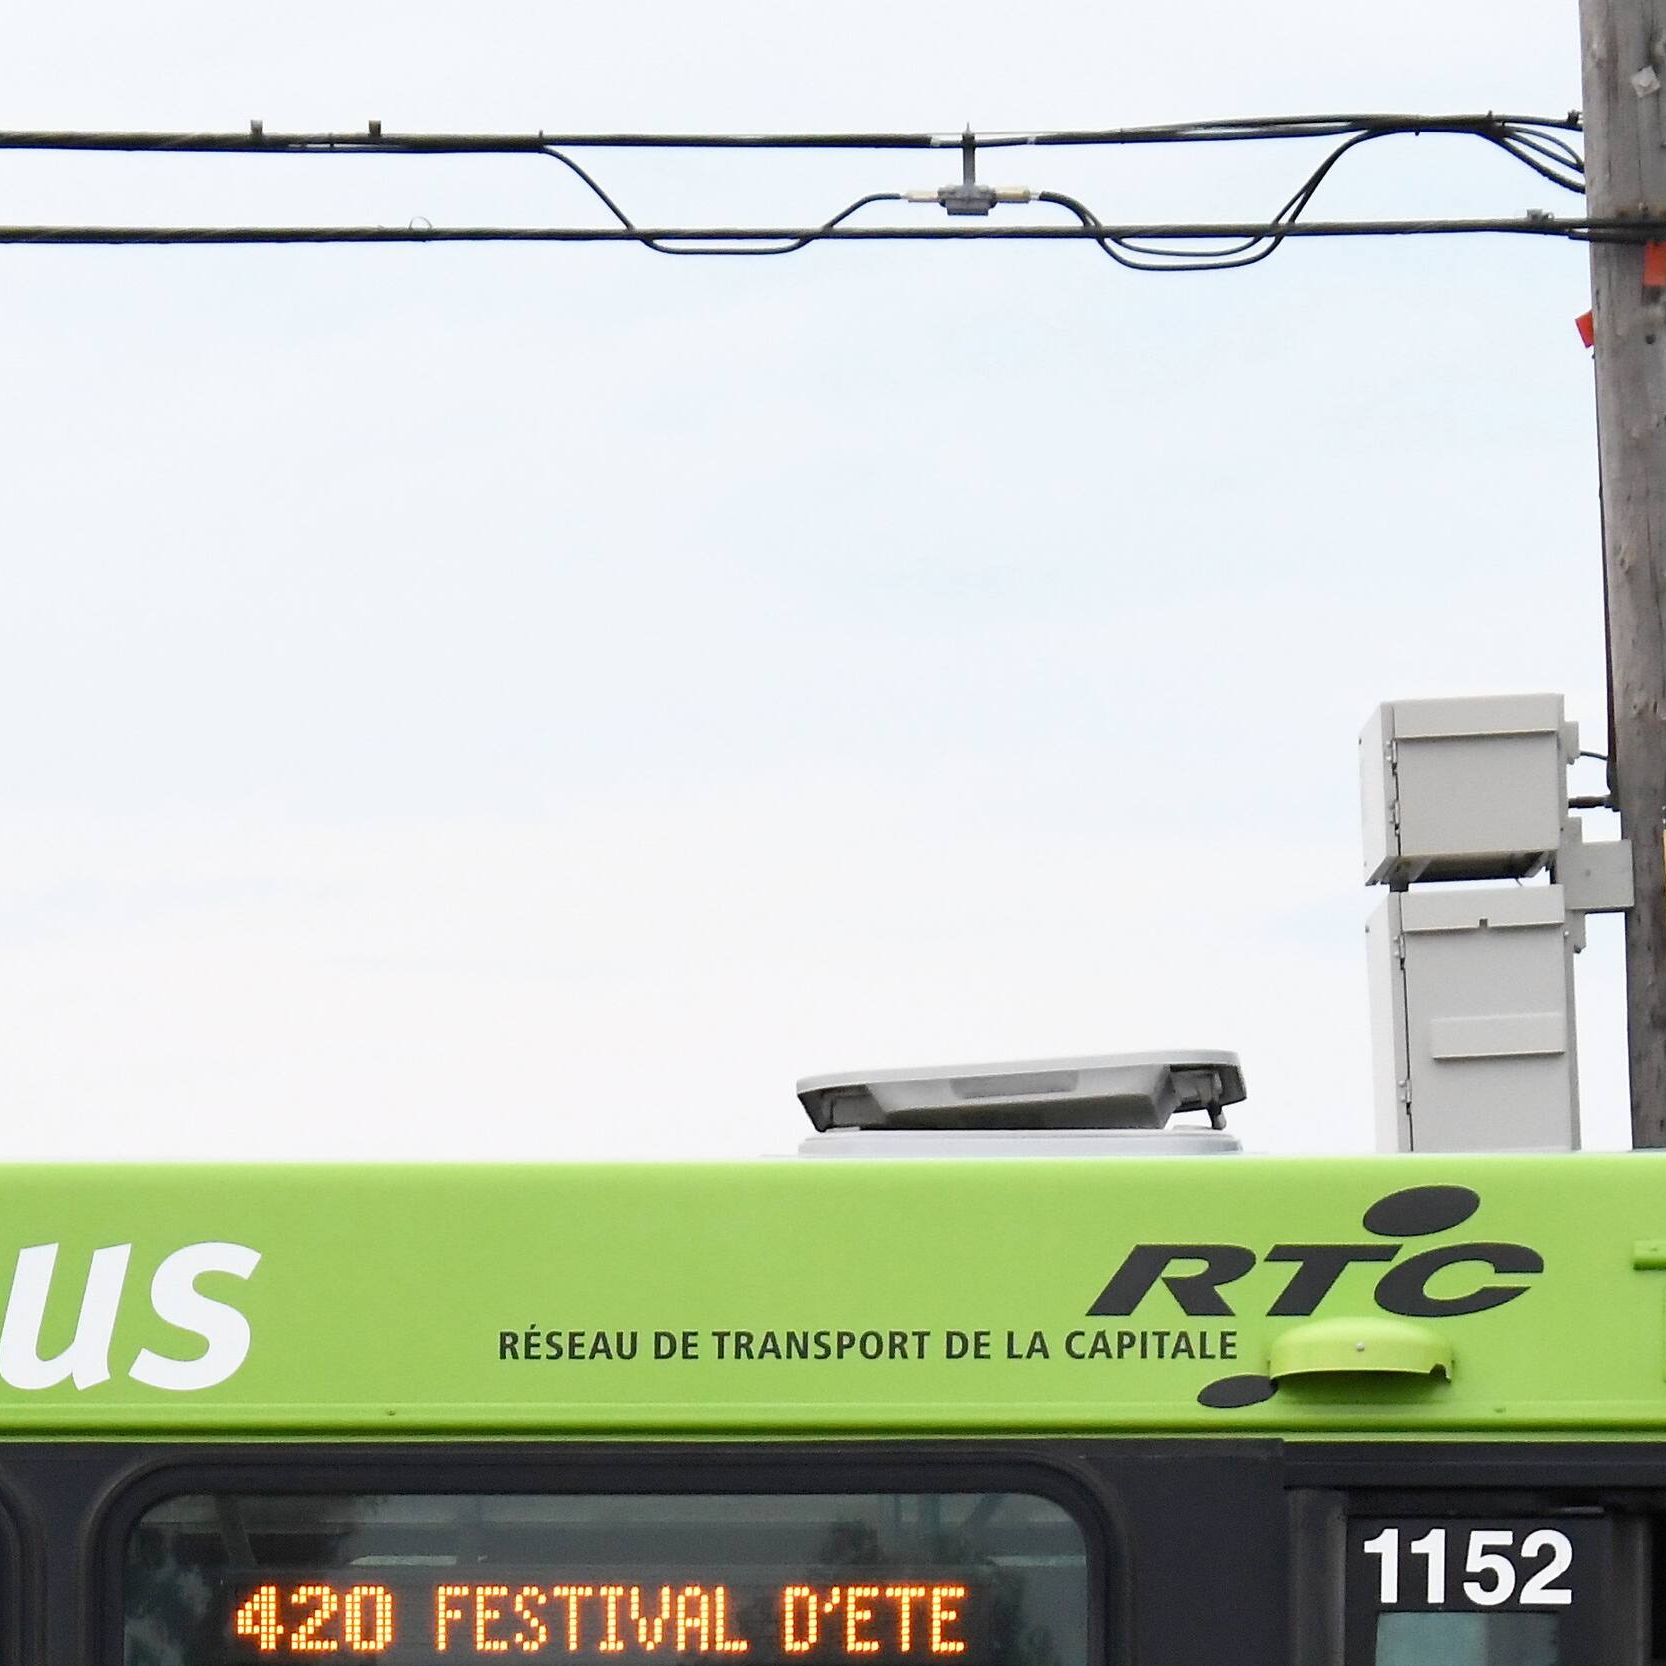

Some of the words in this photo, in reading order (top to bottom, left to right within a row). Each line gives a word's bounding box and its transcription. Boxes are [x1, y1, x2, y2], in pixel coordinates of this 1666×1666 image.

[1086, 1241, 1545, 1319] RTC
[498, 1324, 638, 1361] RÉSEAU
[653, 1330, 699, 1360] DE
[711, 1330, 931, 1361] TRANSPORT
[944, 1330, 992, 1360] DE
[1006, 1330, 1050, 1360] LA
[1063, 1330, 1238, 1360] CAPITALE
[1363, 1527, 1574, 1606] 1152
[236, 1584, 394, 1651] 420
[437, 1584, 749, 1652] FESTIVAL
[784, 1584, 967, 1652] D'ETE
